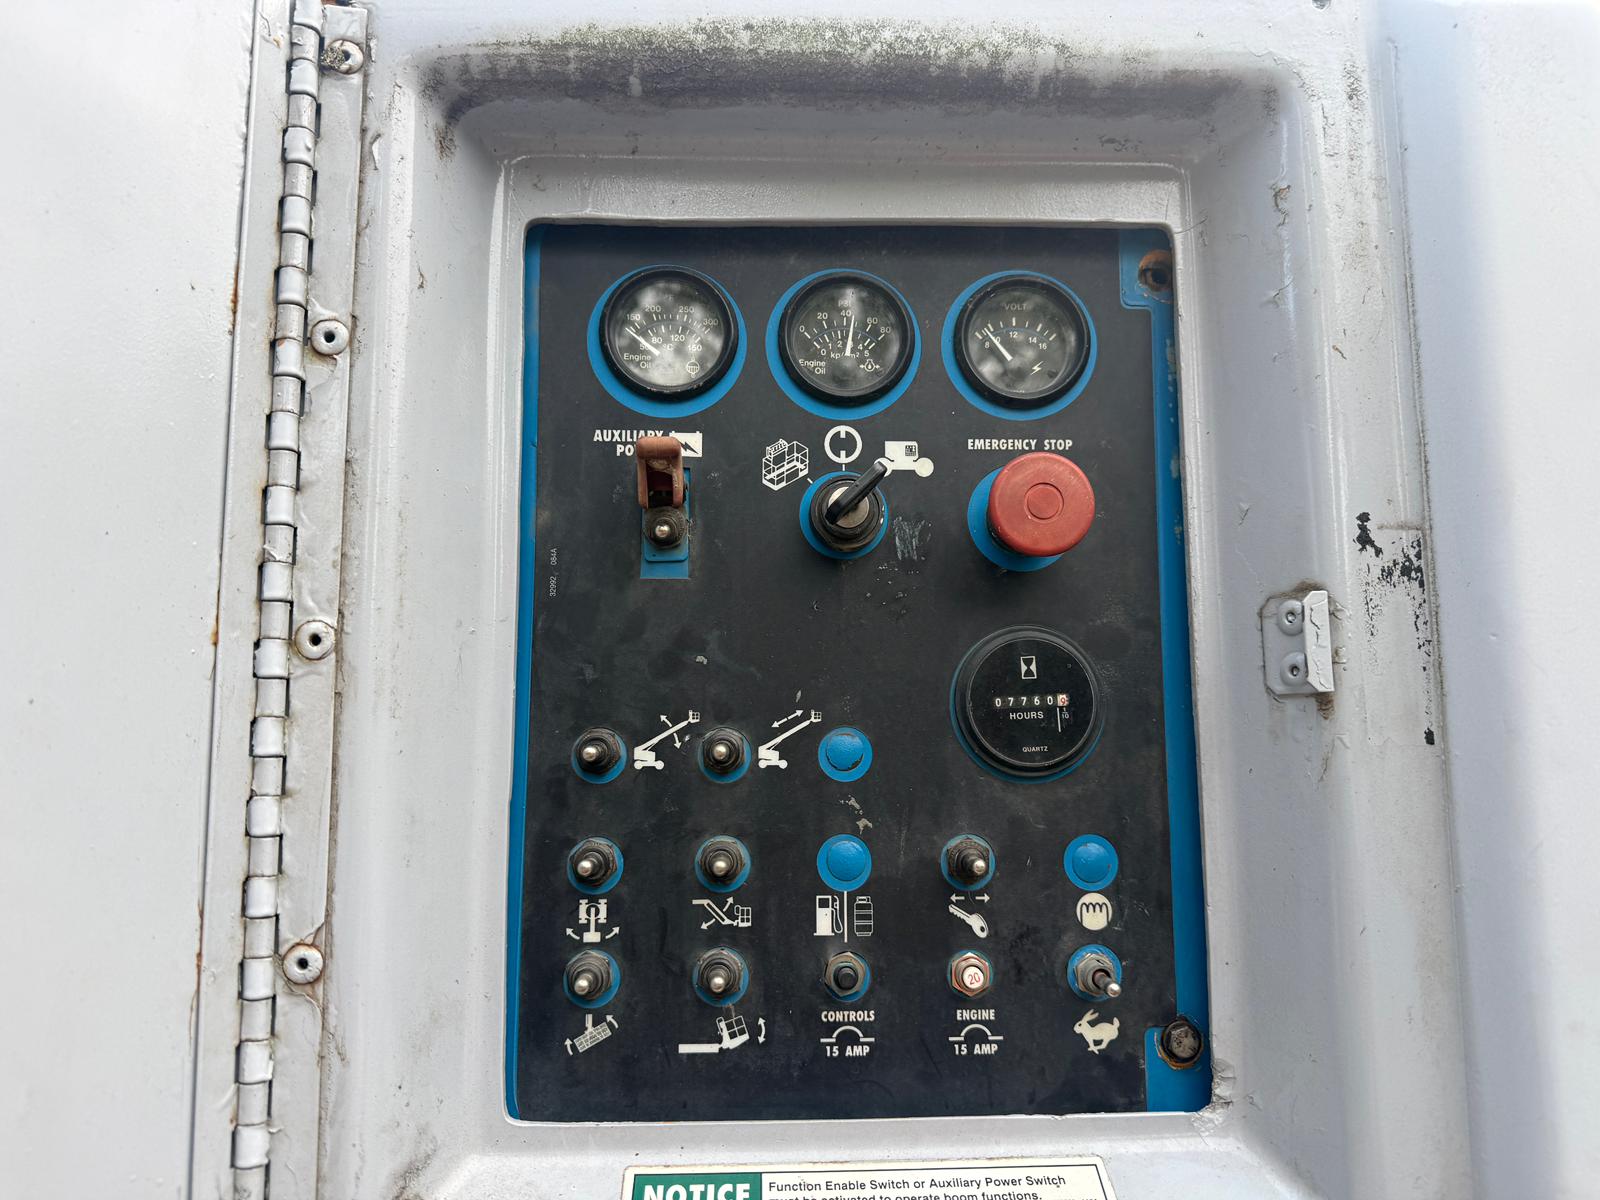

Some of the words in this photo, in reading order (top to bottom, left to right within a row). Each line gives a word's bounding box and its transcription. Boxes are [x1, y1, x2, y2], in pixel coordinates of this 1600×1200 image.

[679, 305, 695, 313] 250
[1004, 303, 1028, 311] VOLT
[627, 313, 641, 321] 150
[817, 312, 828, 320] 20
[703, 318, 719, 326] 300
[867, 317, 878, 325] 60
[799, 325, 805, 333] 0
[880, 326, 892, 334] 80
[651, 336, 663, 344] 80
[670, 334, 685, 342] 120
[1028, 336, 1037, 344] 14
[1039, 342, 1047, 350] 16
[623, 353, 651, 362] Engine
[640, 361, 651, 369] Oil
[799, 359, 826, 368] Engine
[815, 367, 826, 375] Oil
[967, 438, 1037, 450] EMERGENCY
[1044, 439, 1073, 450] STOP
[1009, 711, 1044, 720] HOURS
[967, 973, 981, 985] 20
[821, 1010, 875, 1022] CONTROLS
[956, 1008, 996, 1020] ENGINE
[825, 1046, 839, 1057] 15
[845, 1045, 870, 1056] AMP
[953, 1044, 968, 1055] 15
[973, 1043, 998, 1055] AMP
[768, 1180, 822, 1192] Function
[825, 1180, 866, 1191] Enable
[870, 1178, 909, 1190] Switch
[913, 1179, 925, 1189] or
[929, 1176, 981, 1190] Auxiliary
[985, 1176, 1022, 1187] Power
[1025, 1174, 1067, 1187] Switch
[643, 1183, 751, 1200] NOTICE
[943, 1192, 978, 1200] boom
[981, 1190, 1043, 1200] functions.
